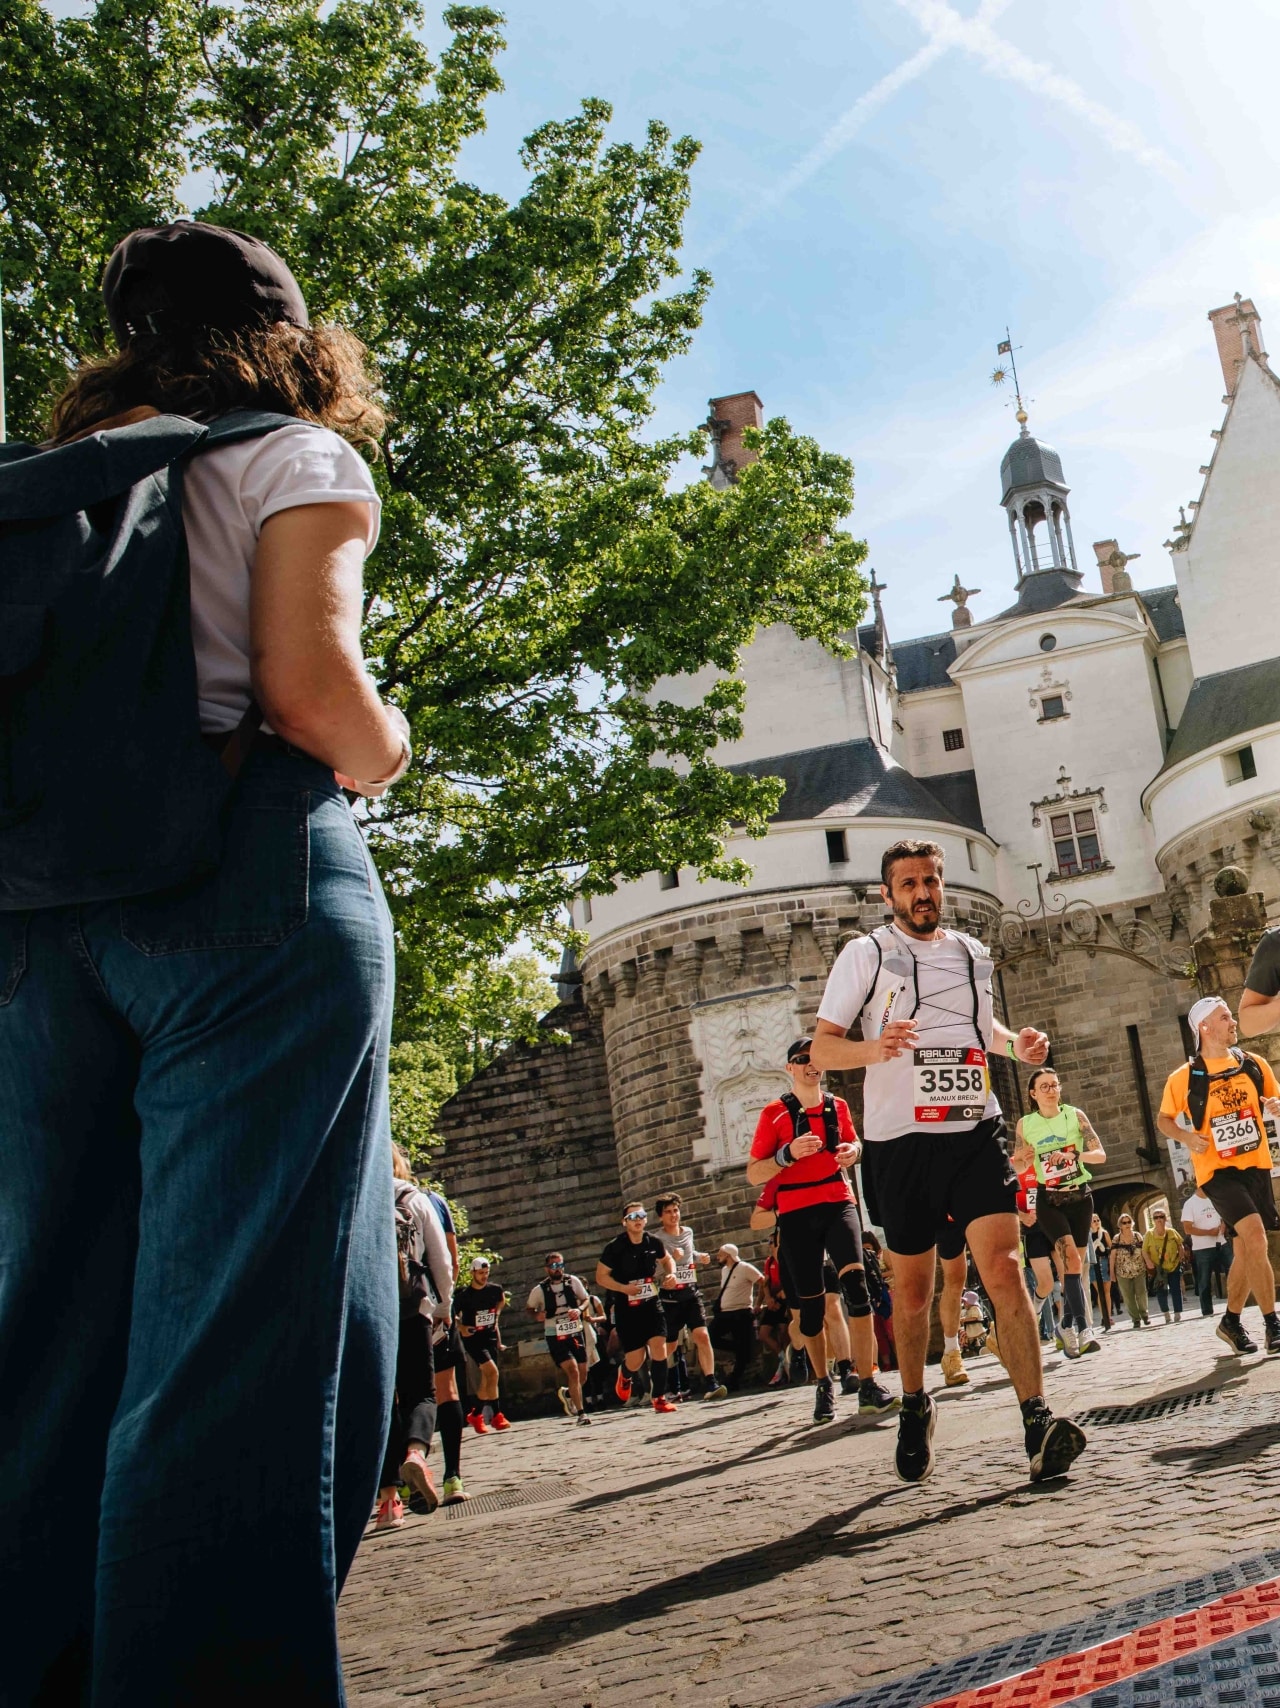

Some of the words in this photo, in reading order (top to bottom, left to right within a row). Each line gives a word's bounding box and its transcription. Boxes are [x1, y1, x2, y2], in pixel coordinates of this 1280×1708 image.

[919, 1049, 962, 1058] ABALONE
[919, 1068, 983, 1093] 3558
[1216, 1120, 1254, 1143] 2366
[477, 1315, 495, 1323] 2527
[558, 1321, 578, 1332] 4383
